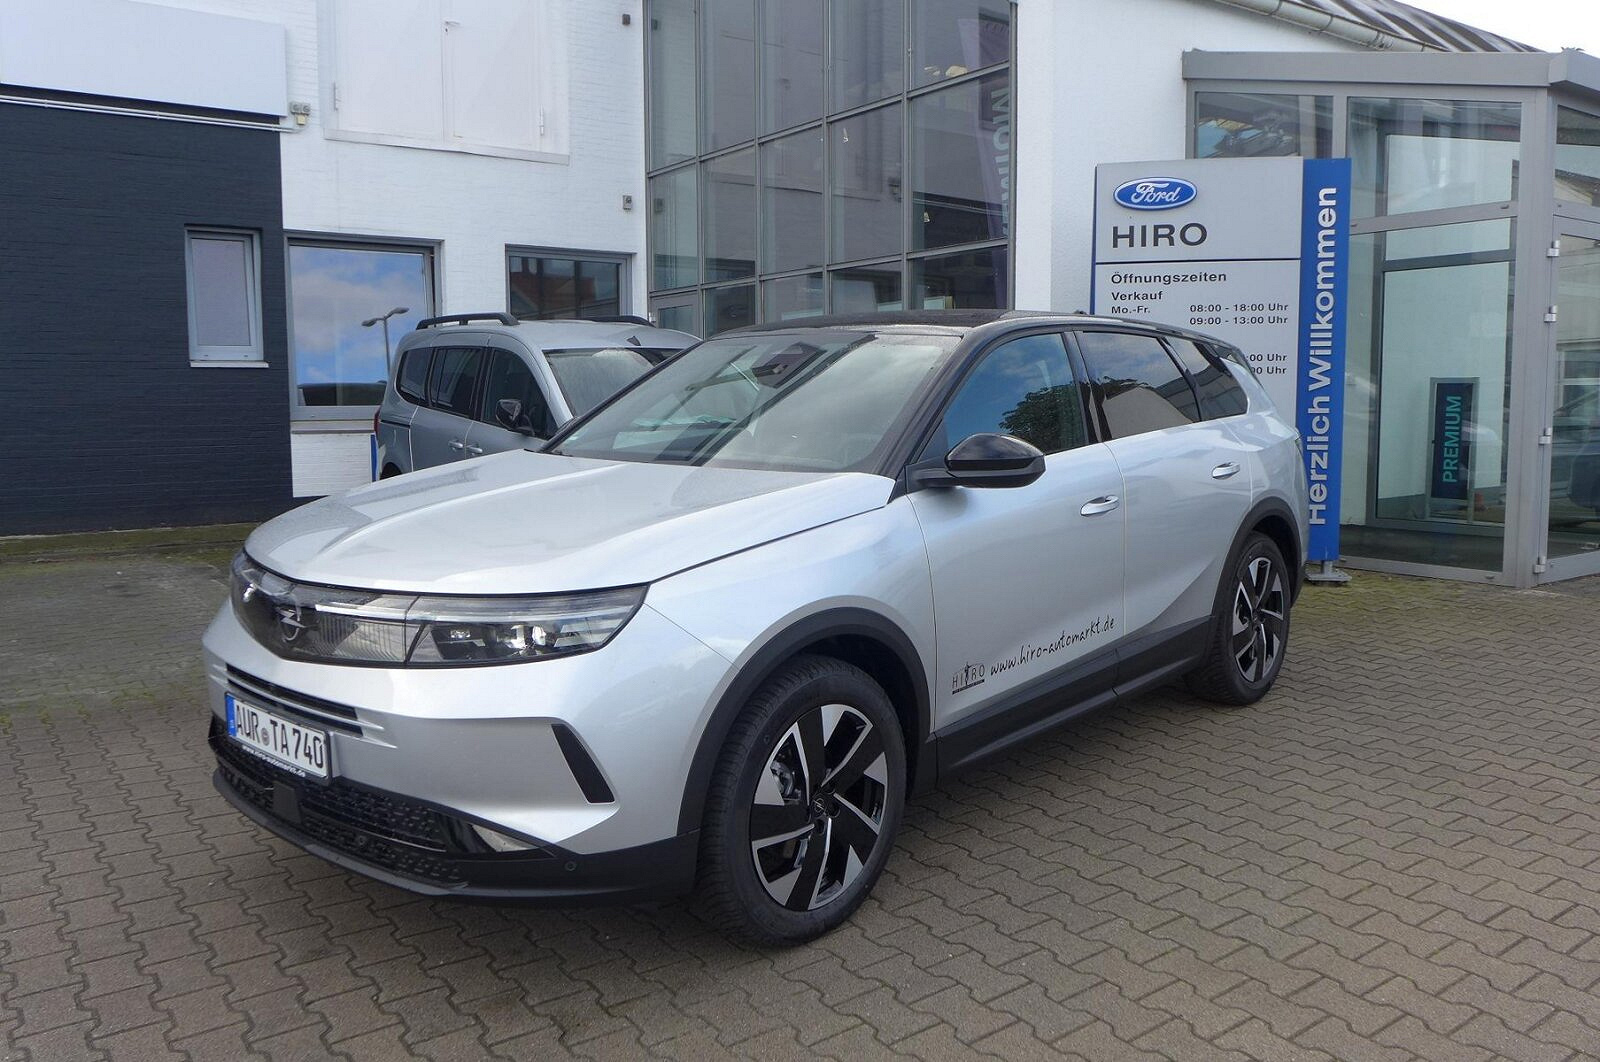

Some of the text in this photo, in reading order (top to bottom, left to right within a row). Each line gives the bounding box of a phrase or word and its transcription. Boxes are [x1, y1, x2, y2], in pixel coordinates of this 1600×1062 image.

[1131, 182, 1180, 204] Ford
[1112, 222, 1208, 248] HIRO
[1111, 271, 1227, 285] Öffnungszeiten
[1111, 290, 1163, 301] Verkauf
[1189, 303, 1222, 313] 08:00
[1233, 303, 1265, 312] 18:00
[1267, 302, 1289, 312] Uhr
[1189, 316, 1222, 325] 09:00
[1233, 316, 1265, 325] 13:00
[1267, 315, 1289, 324] Uhr
[1266, 353, 1288, 362] Uhr
[1307, 187, 1337, 525] Herzlich Willkommen
[1266, 366, 1288, 375] Uhr
[1442, 395, 1462, 484] PREMIUM
[990, 614, 1116, 677] www.hiro-automarkt.de
[236, 704, 260, 744] AUR
[269, 719, 290, 757] TA
[292, 727, 324, 769] 740
